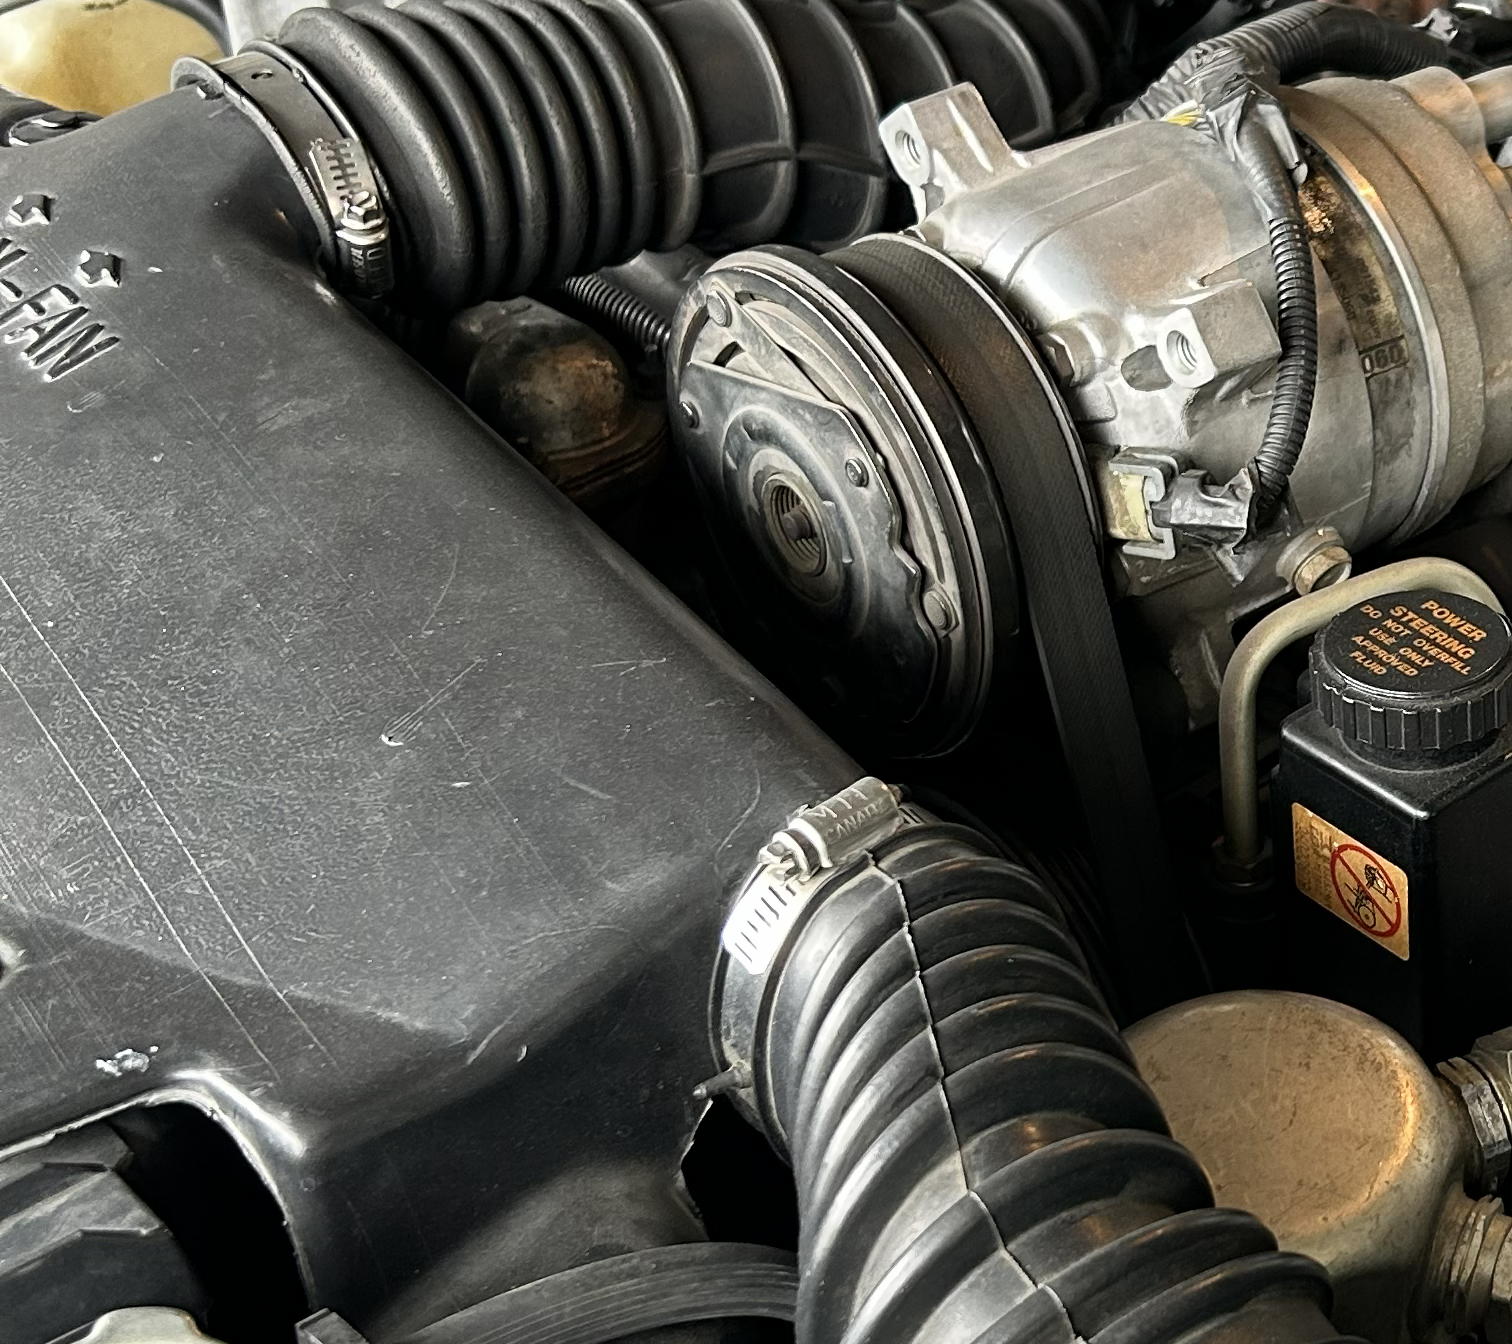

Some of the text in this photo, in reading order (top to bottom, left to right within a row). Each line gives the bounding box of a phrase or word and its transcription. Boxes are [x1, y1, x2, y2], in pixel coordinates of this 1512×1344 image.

[1360, 604, 1472, 676] DO NOT OVERFILL
[1389, 605, 1476, 659] STEERING
[1420, 600, 1487, 642] POWER
[1350, 650, 1388, 676] FLUID
[1351, 635, 1419, 677] APPROVED
[1368, 627, 1435, 668] USE ONLY
